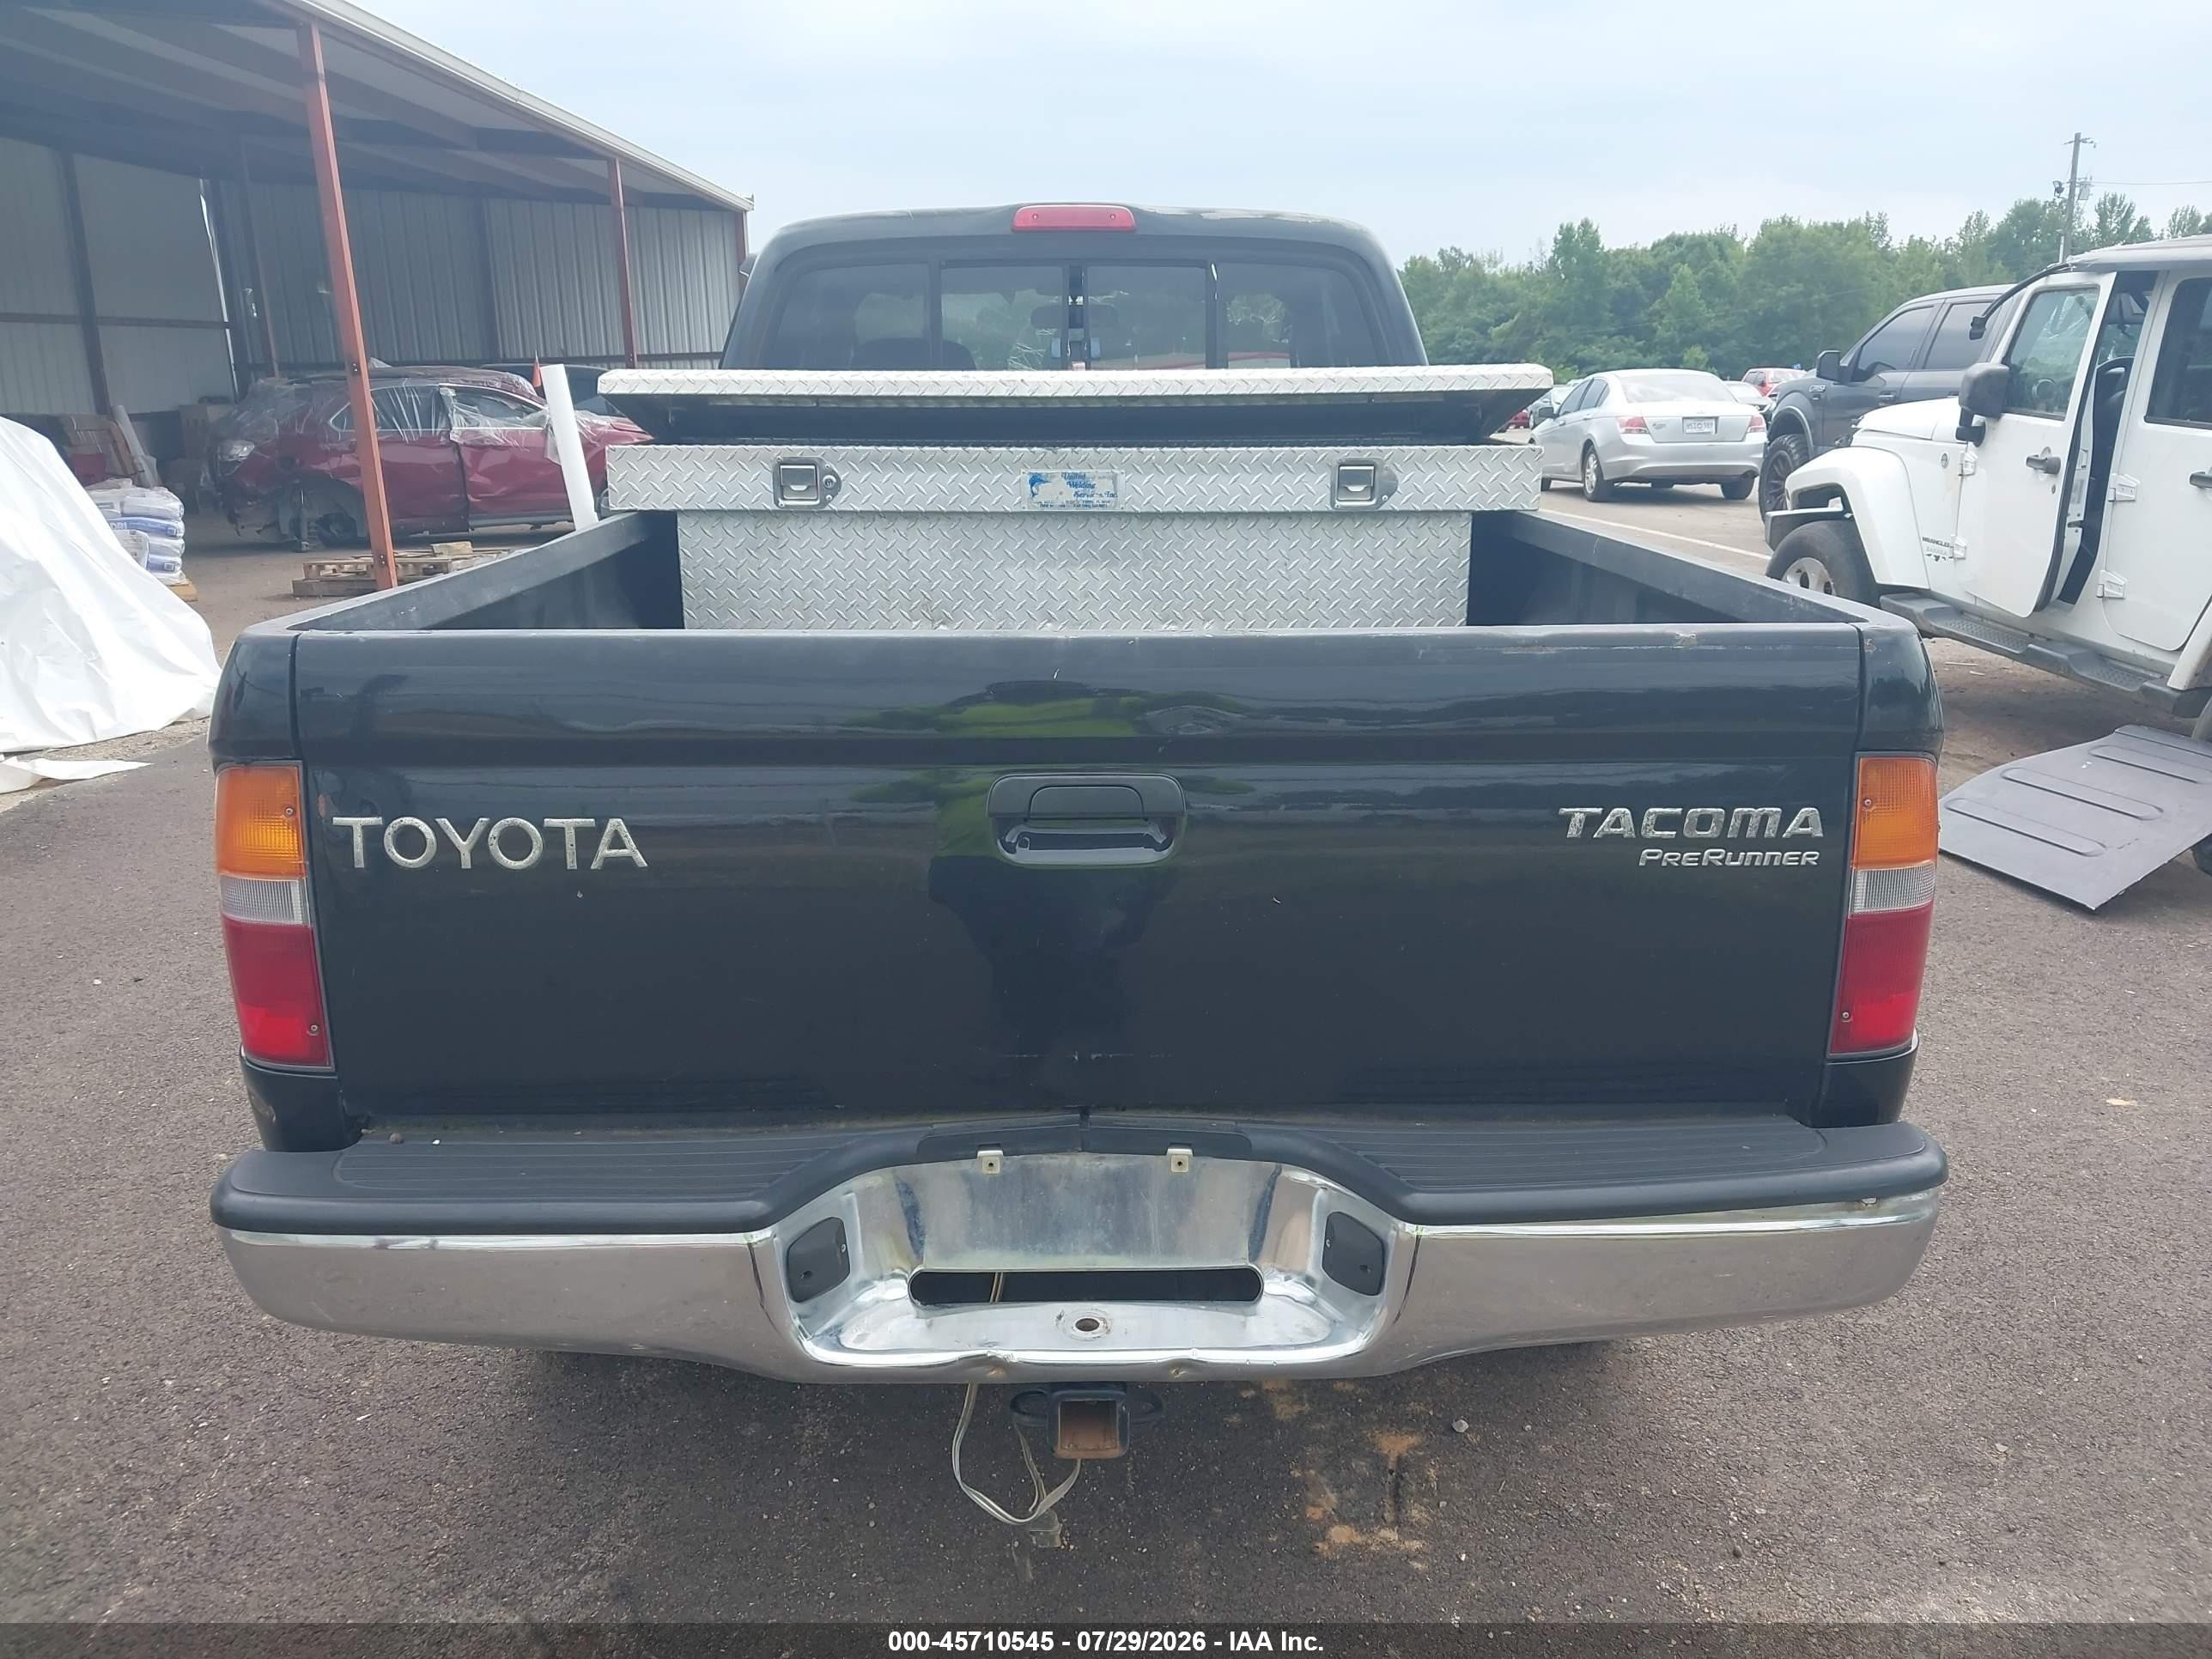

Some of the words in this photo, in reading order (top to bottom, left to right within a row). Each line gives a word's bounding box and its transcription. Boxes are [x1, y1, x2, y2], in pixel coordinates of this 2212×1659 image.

[1060, 471, 1086, 480] United
[1066, 481, 1097, 489] Welding
[1559, 807, 1824, 838] TACOMA
[332, 816, 648, 870] TOYOTA
